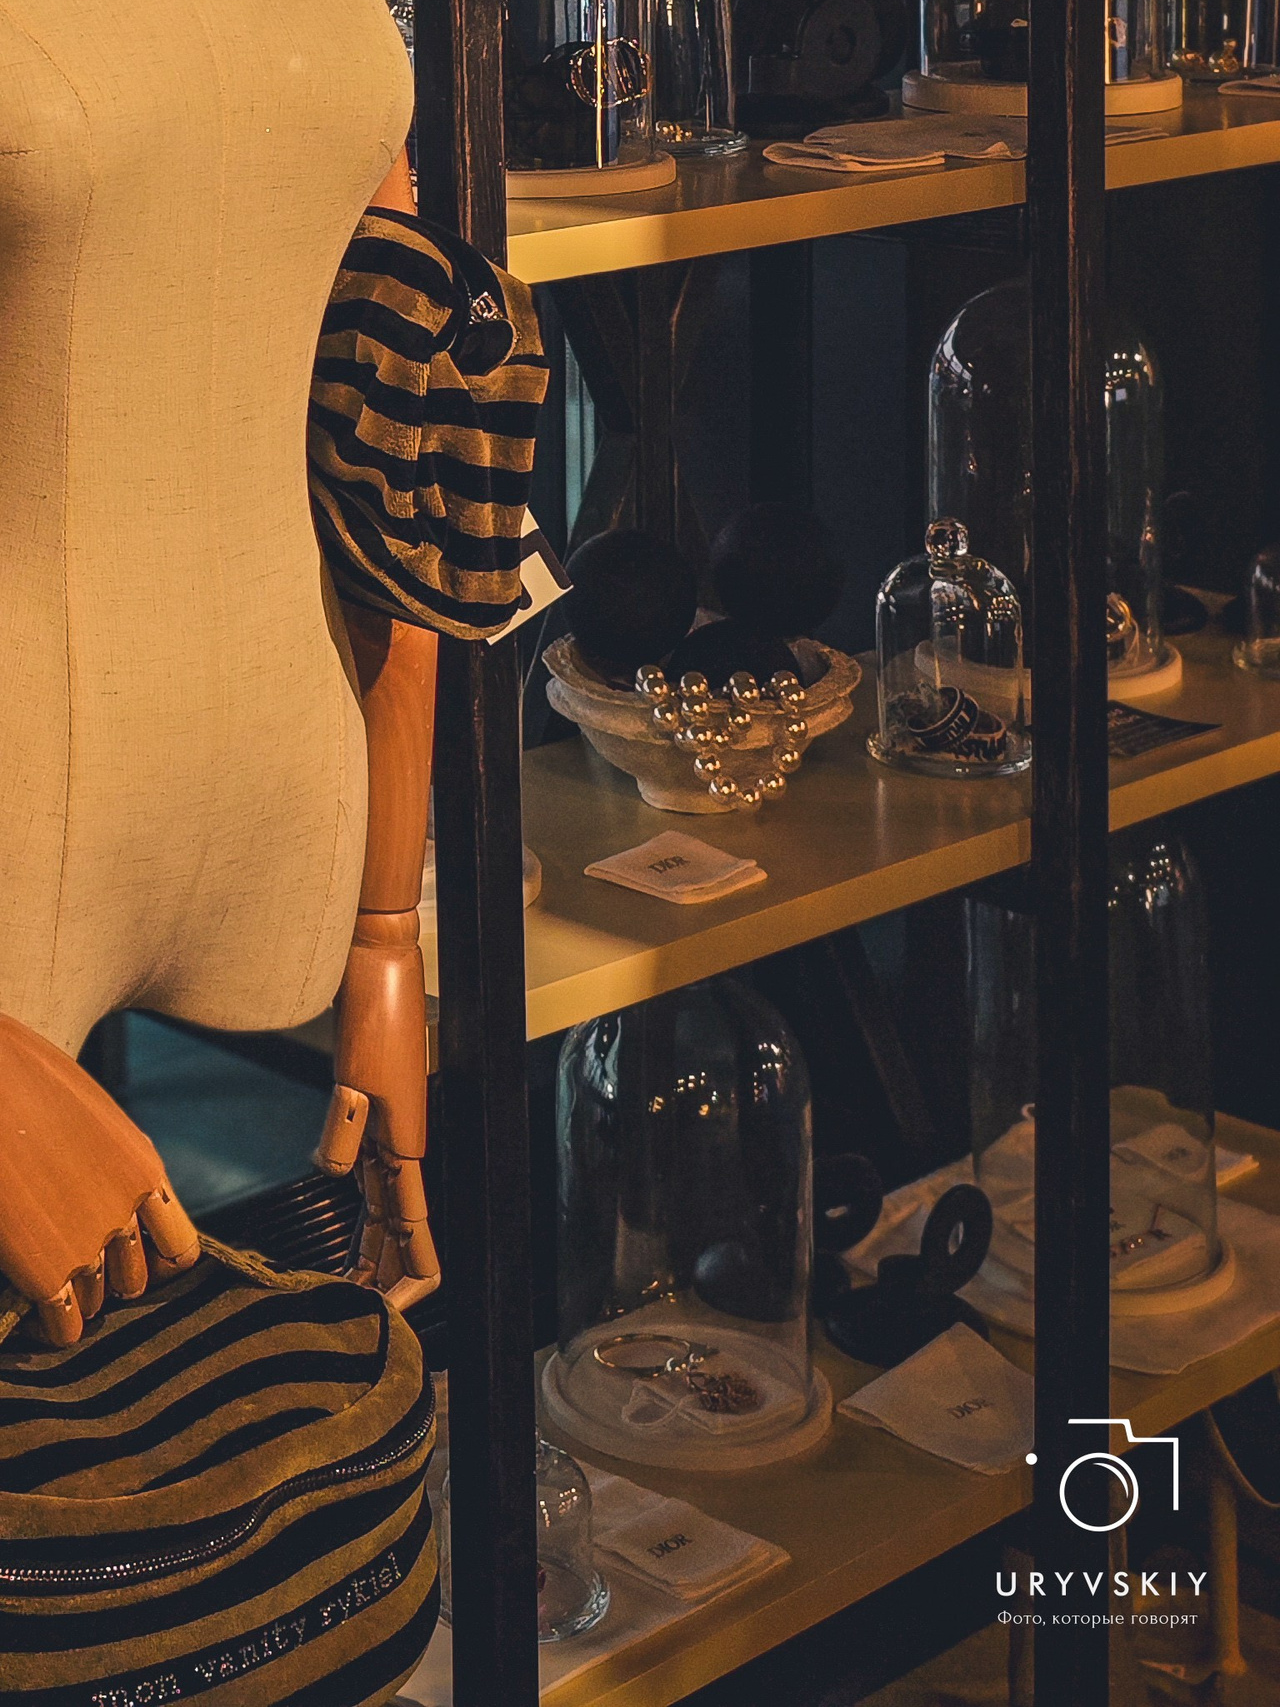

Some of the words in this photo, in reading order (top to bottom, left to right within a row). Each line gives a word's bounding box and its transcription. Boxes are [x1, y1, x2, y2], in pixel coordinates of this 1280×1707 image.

[647, 1533, 693, 1559] DIOR
[92, 1672, 181, 1707] mon
[194, 1615, 307, 1682] vanity
[320, 1551, 403, 1626] rykiel
